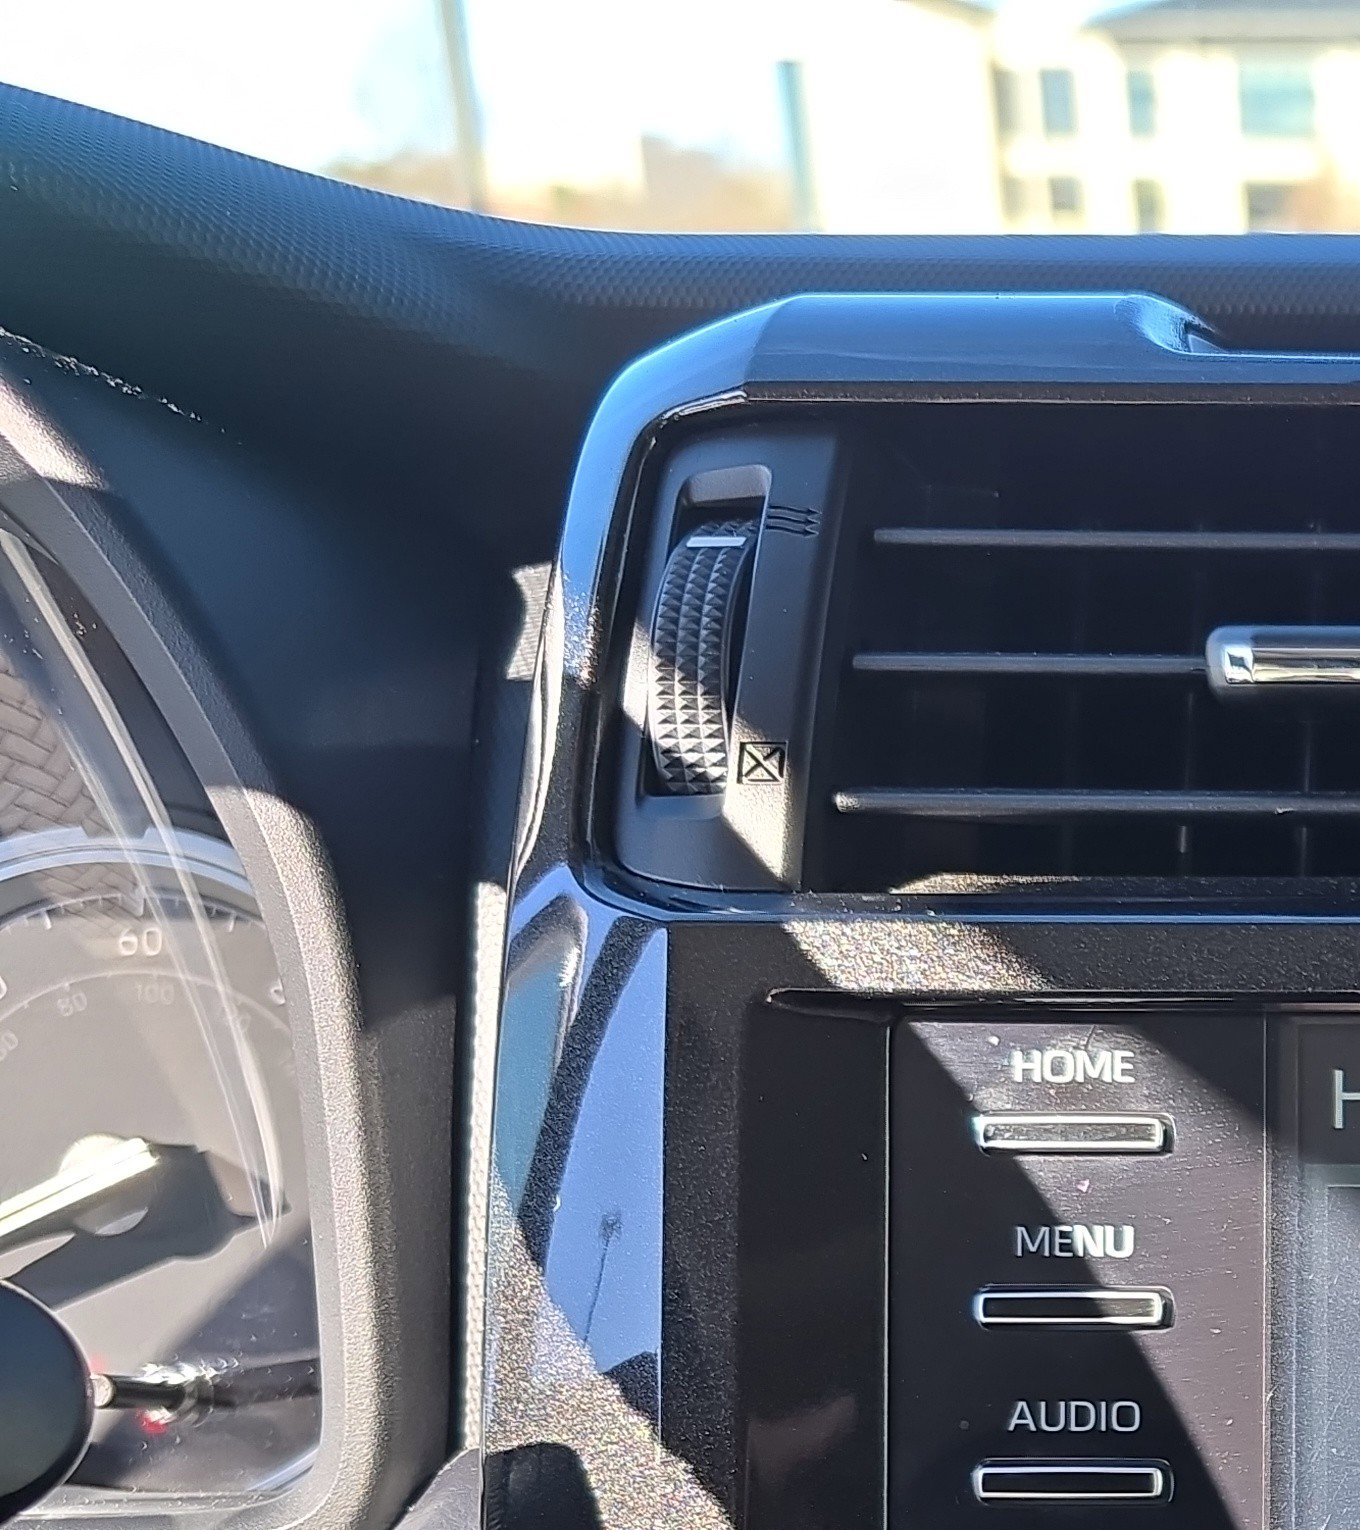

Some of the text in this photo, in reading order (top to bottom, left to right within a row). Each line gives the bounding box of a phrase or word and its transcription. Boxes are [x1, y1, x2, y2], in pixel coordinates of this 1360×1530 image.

[118, 928, 164, 957] 60
[1012, 1049, 1136, 1083] HOME
[1014, 1225, 1135, 1258] MENU
[1007, 1400, 1142, 1432] AUDIO
